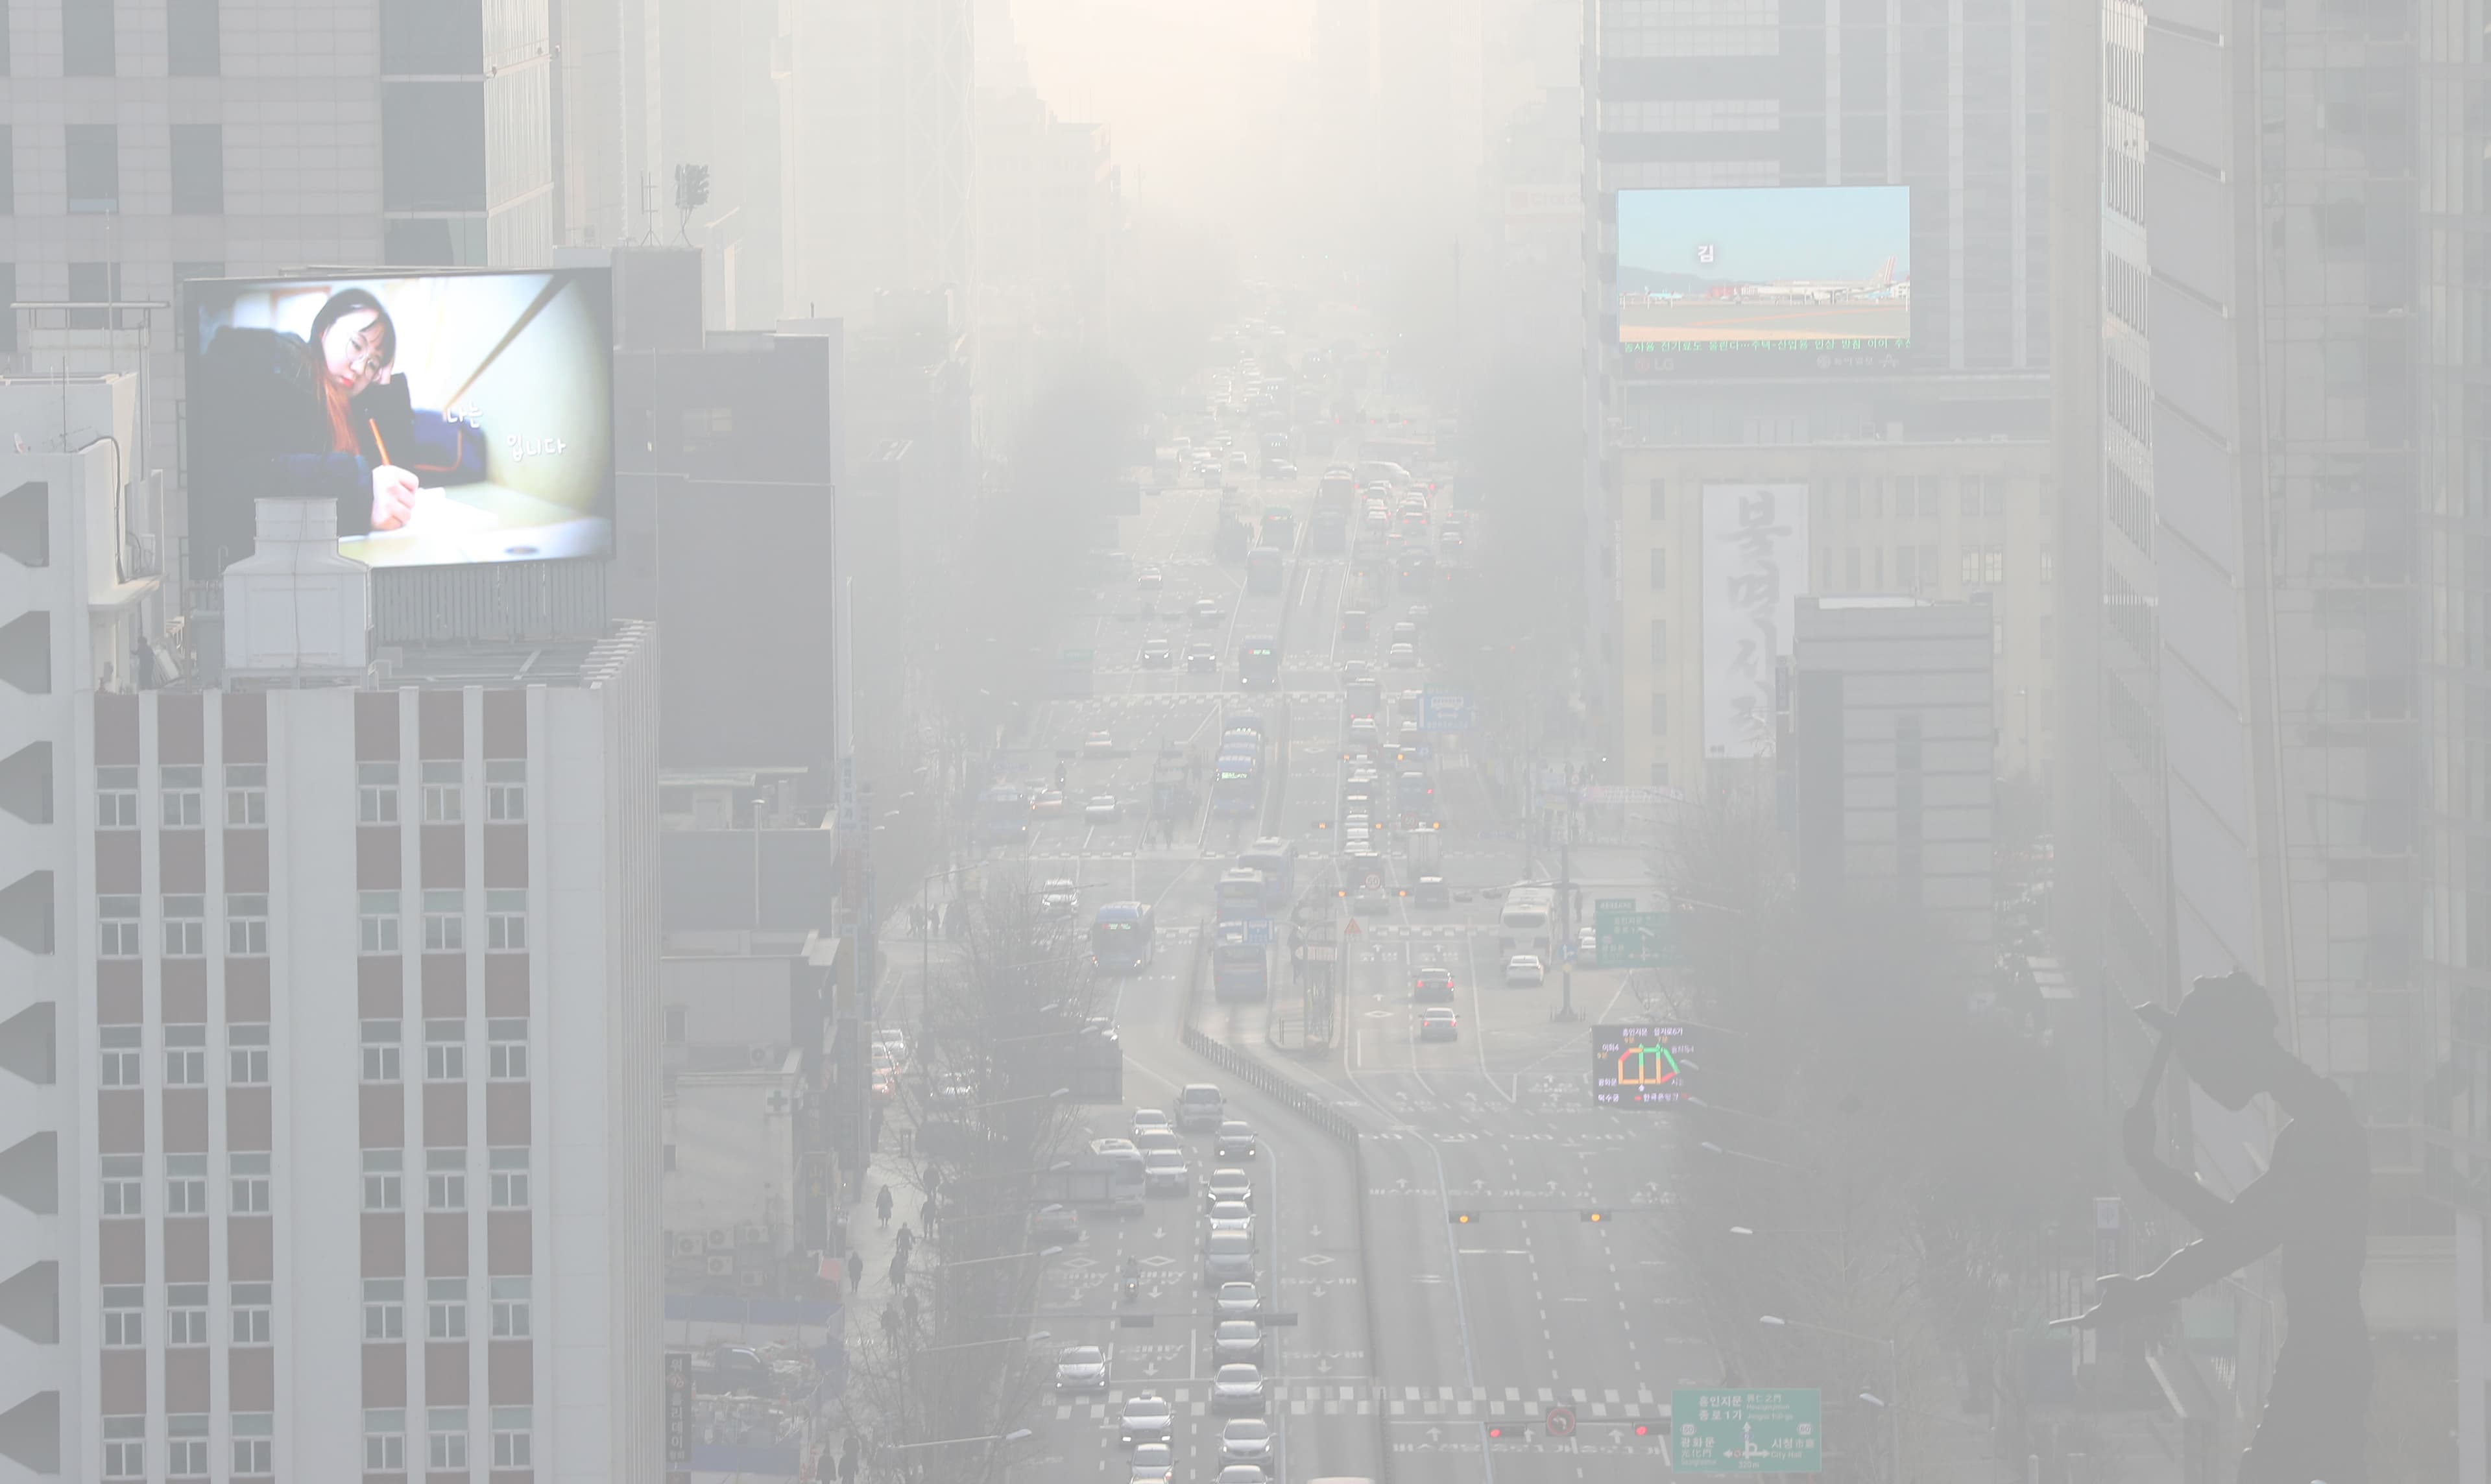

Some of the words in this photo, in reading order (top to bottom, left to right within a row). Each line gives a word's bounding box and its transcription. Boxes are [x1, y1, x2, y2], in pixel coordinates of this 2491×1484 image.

[1531, 192, 1579, 207] 다이소
[1698, 244, 1714, 263] 김
[1654, 358, 1674, 370] LG
[446, 400, 483, 428] 나는
[506, 433, 566, 462] 입니다
[1698, 1395, 1742, 1407] 흥인지문
[1681, 1437, 1715, 1448] 광화문
[1771, 1437, 1792, 1448] 시청
[1771, 1451, 1786, 1461] City
